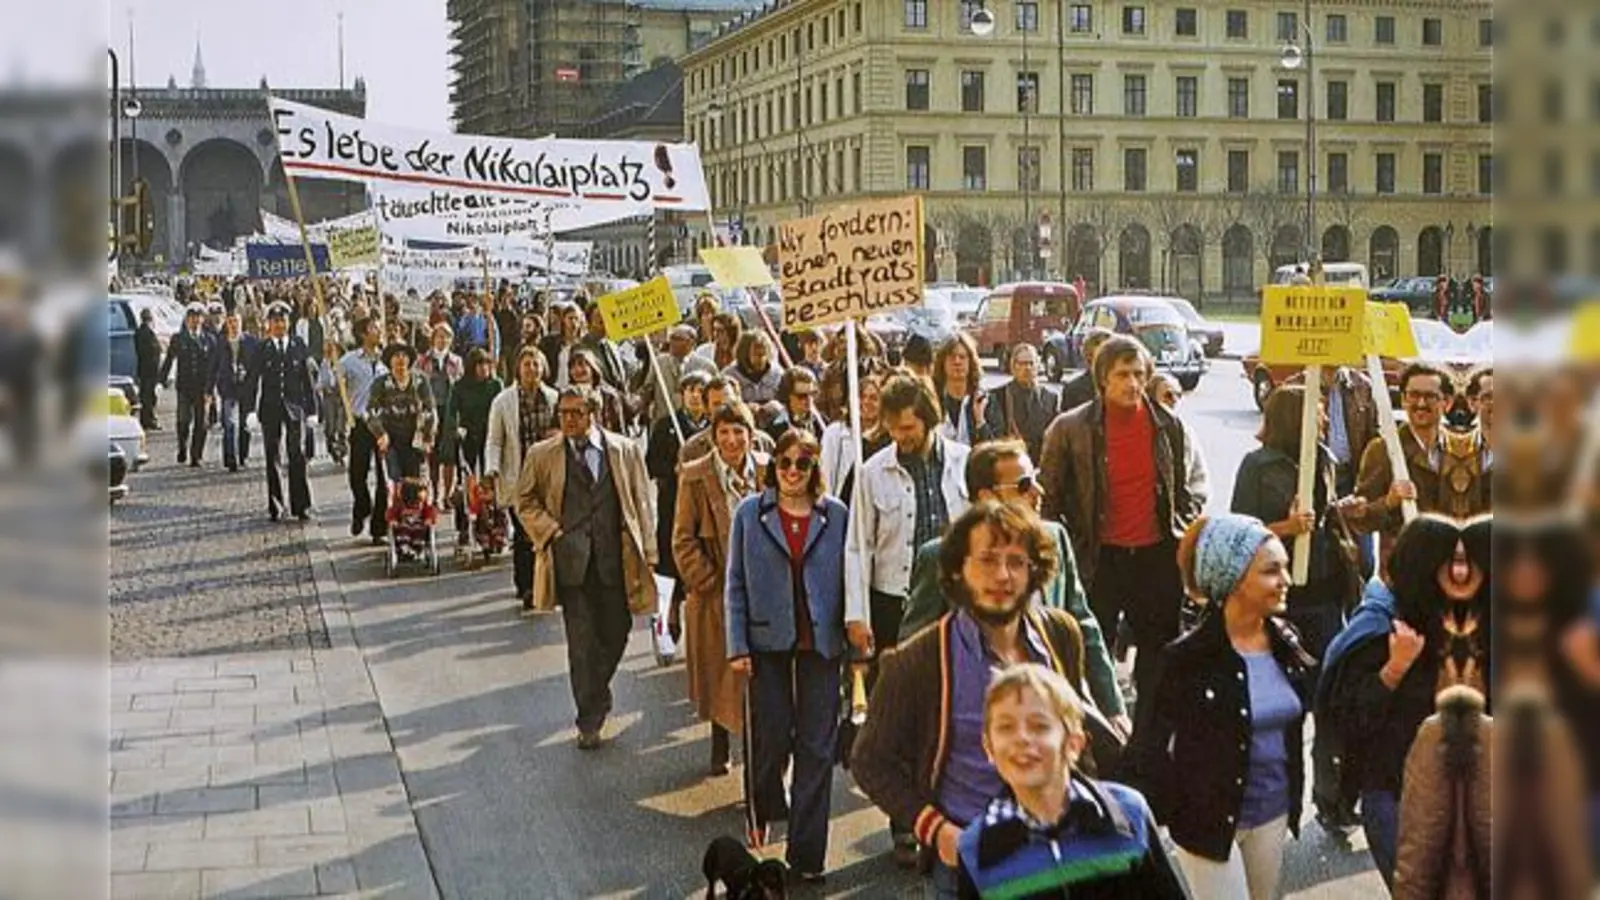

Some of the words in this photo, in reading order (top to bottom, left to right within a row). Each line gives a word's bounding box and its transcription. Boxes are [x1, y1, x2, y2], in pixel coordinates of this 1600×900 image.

[274, 109, 316, 159] Es
[325, 120, 398, 171] lebe
[404, 140, 455, 175] der
[780, 225, 805, 252] Wir
[818, 208, 911, 254] fordern:
[783, 251, 838, 279] einen
[852, 239, 914, 263] neuen
[785, 286, 921, 326] beschluss
